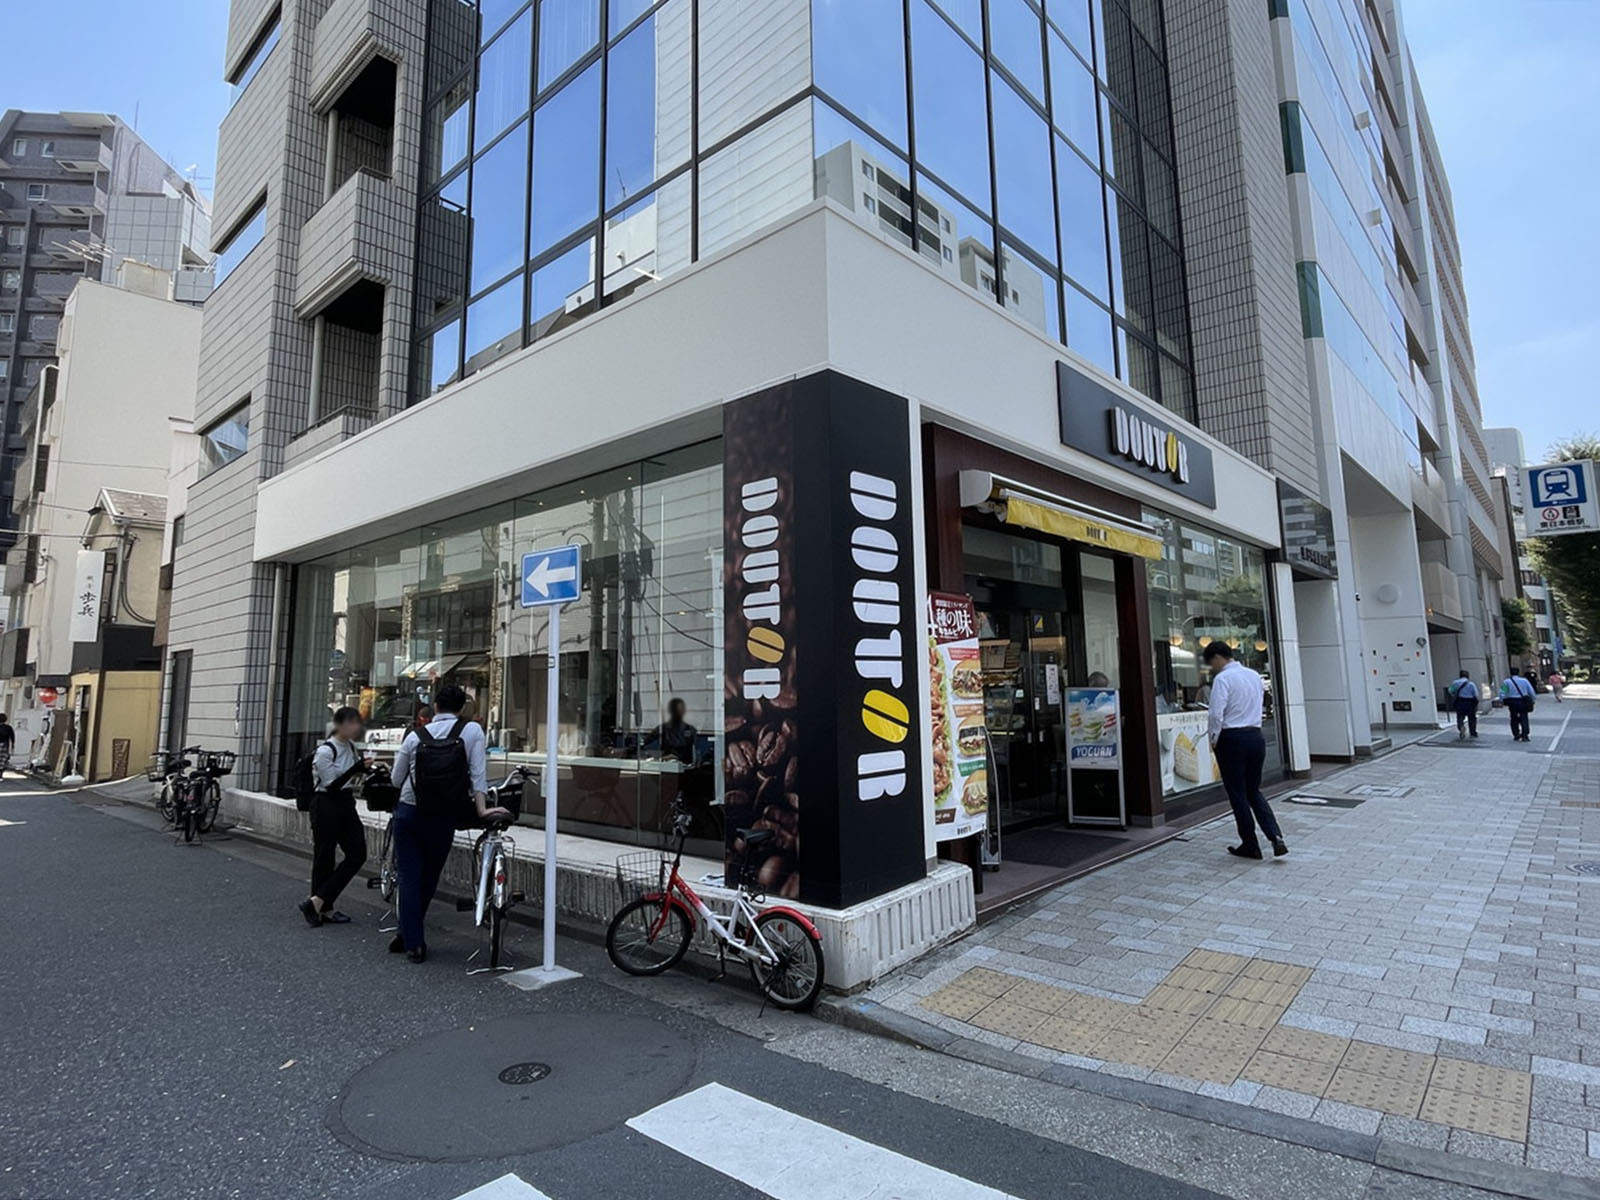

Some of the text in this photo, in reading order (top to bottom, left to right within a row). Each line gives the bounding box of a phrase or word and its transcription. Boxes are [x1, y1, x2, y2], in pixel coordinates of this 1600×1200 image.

[1112, 405, 1190, 484] DOUTOR
[741, 475, 786, 701] DOUTOR
[849, 469, 911, 802] DOUTOR
